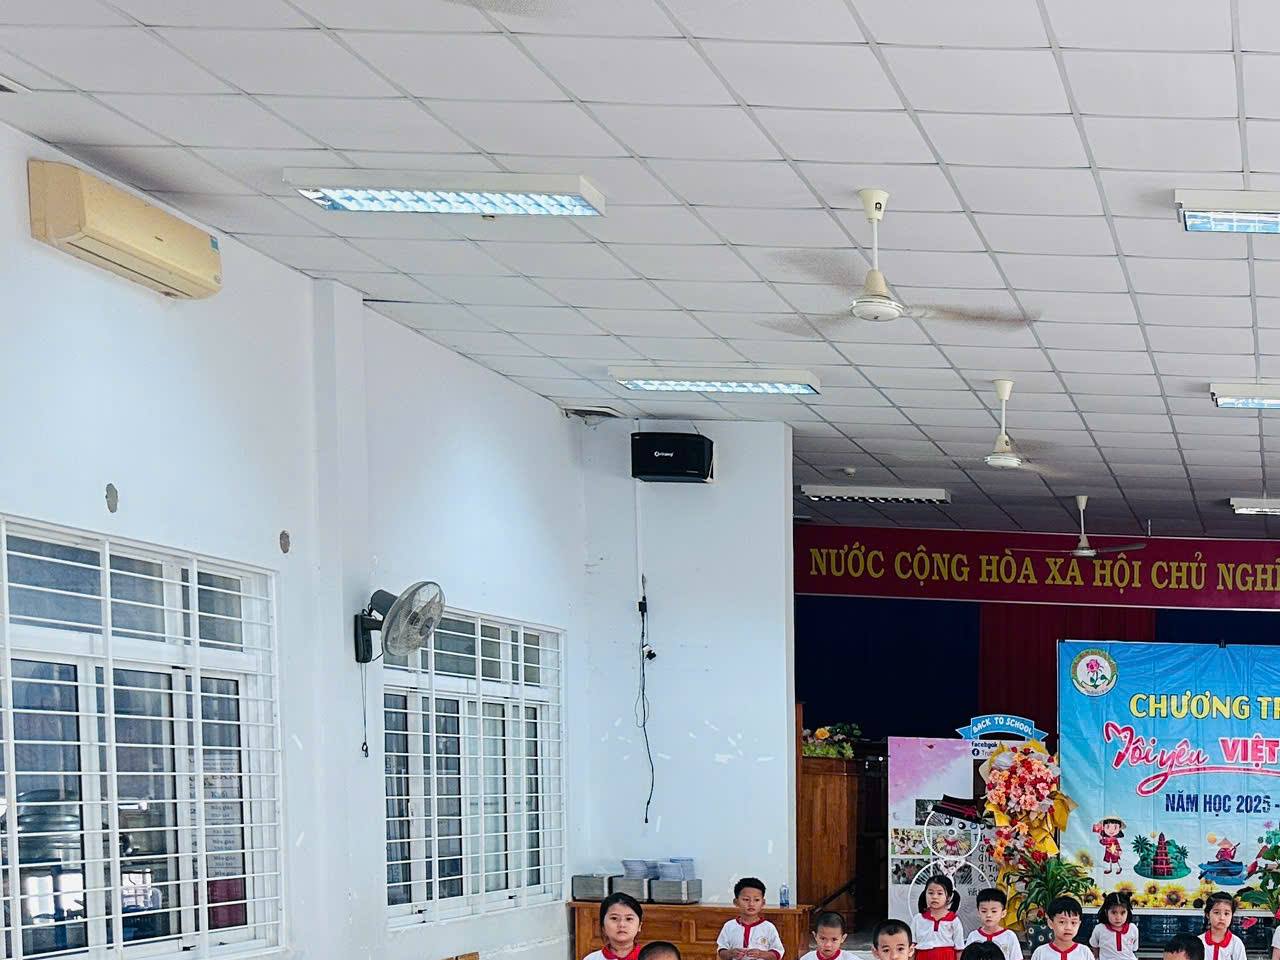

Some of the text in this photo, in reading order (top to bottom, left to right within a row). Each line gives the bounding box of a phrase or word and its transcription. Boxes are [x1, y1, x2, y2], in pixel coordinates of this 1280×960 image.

[809, 541, 885, 578] NƯỚC
[894, 544, 970, 586] CỘNG
[979, 548, 1038, 584] HÒA
[1092, 552, 1142, 594] HỘI
[1150, 551, 1207, 589] CHỦ
[1129, 690, 1250, 720] CHƯƠNG
[972, 716, 1033, 736] BACK TO SCHOOL
[1219, 733, 1280, 770] VIỆT
[1165, 790, 1199, 813] NĂM
[1203, 794, 1232, 817] HỌC
